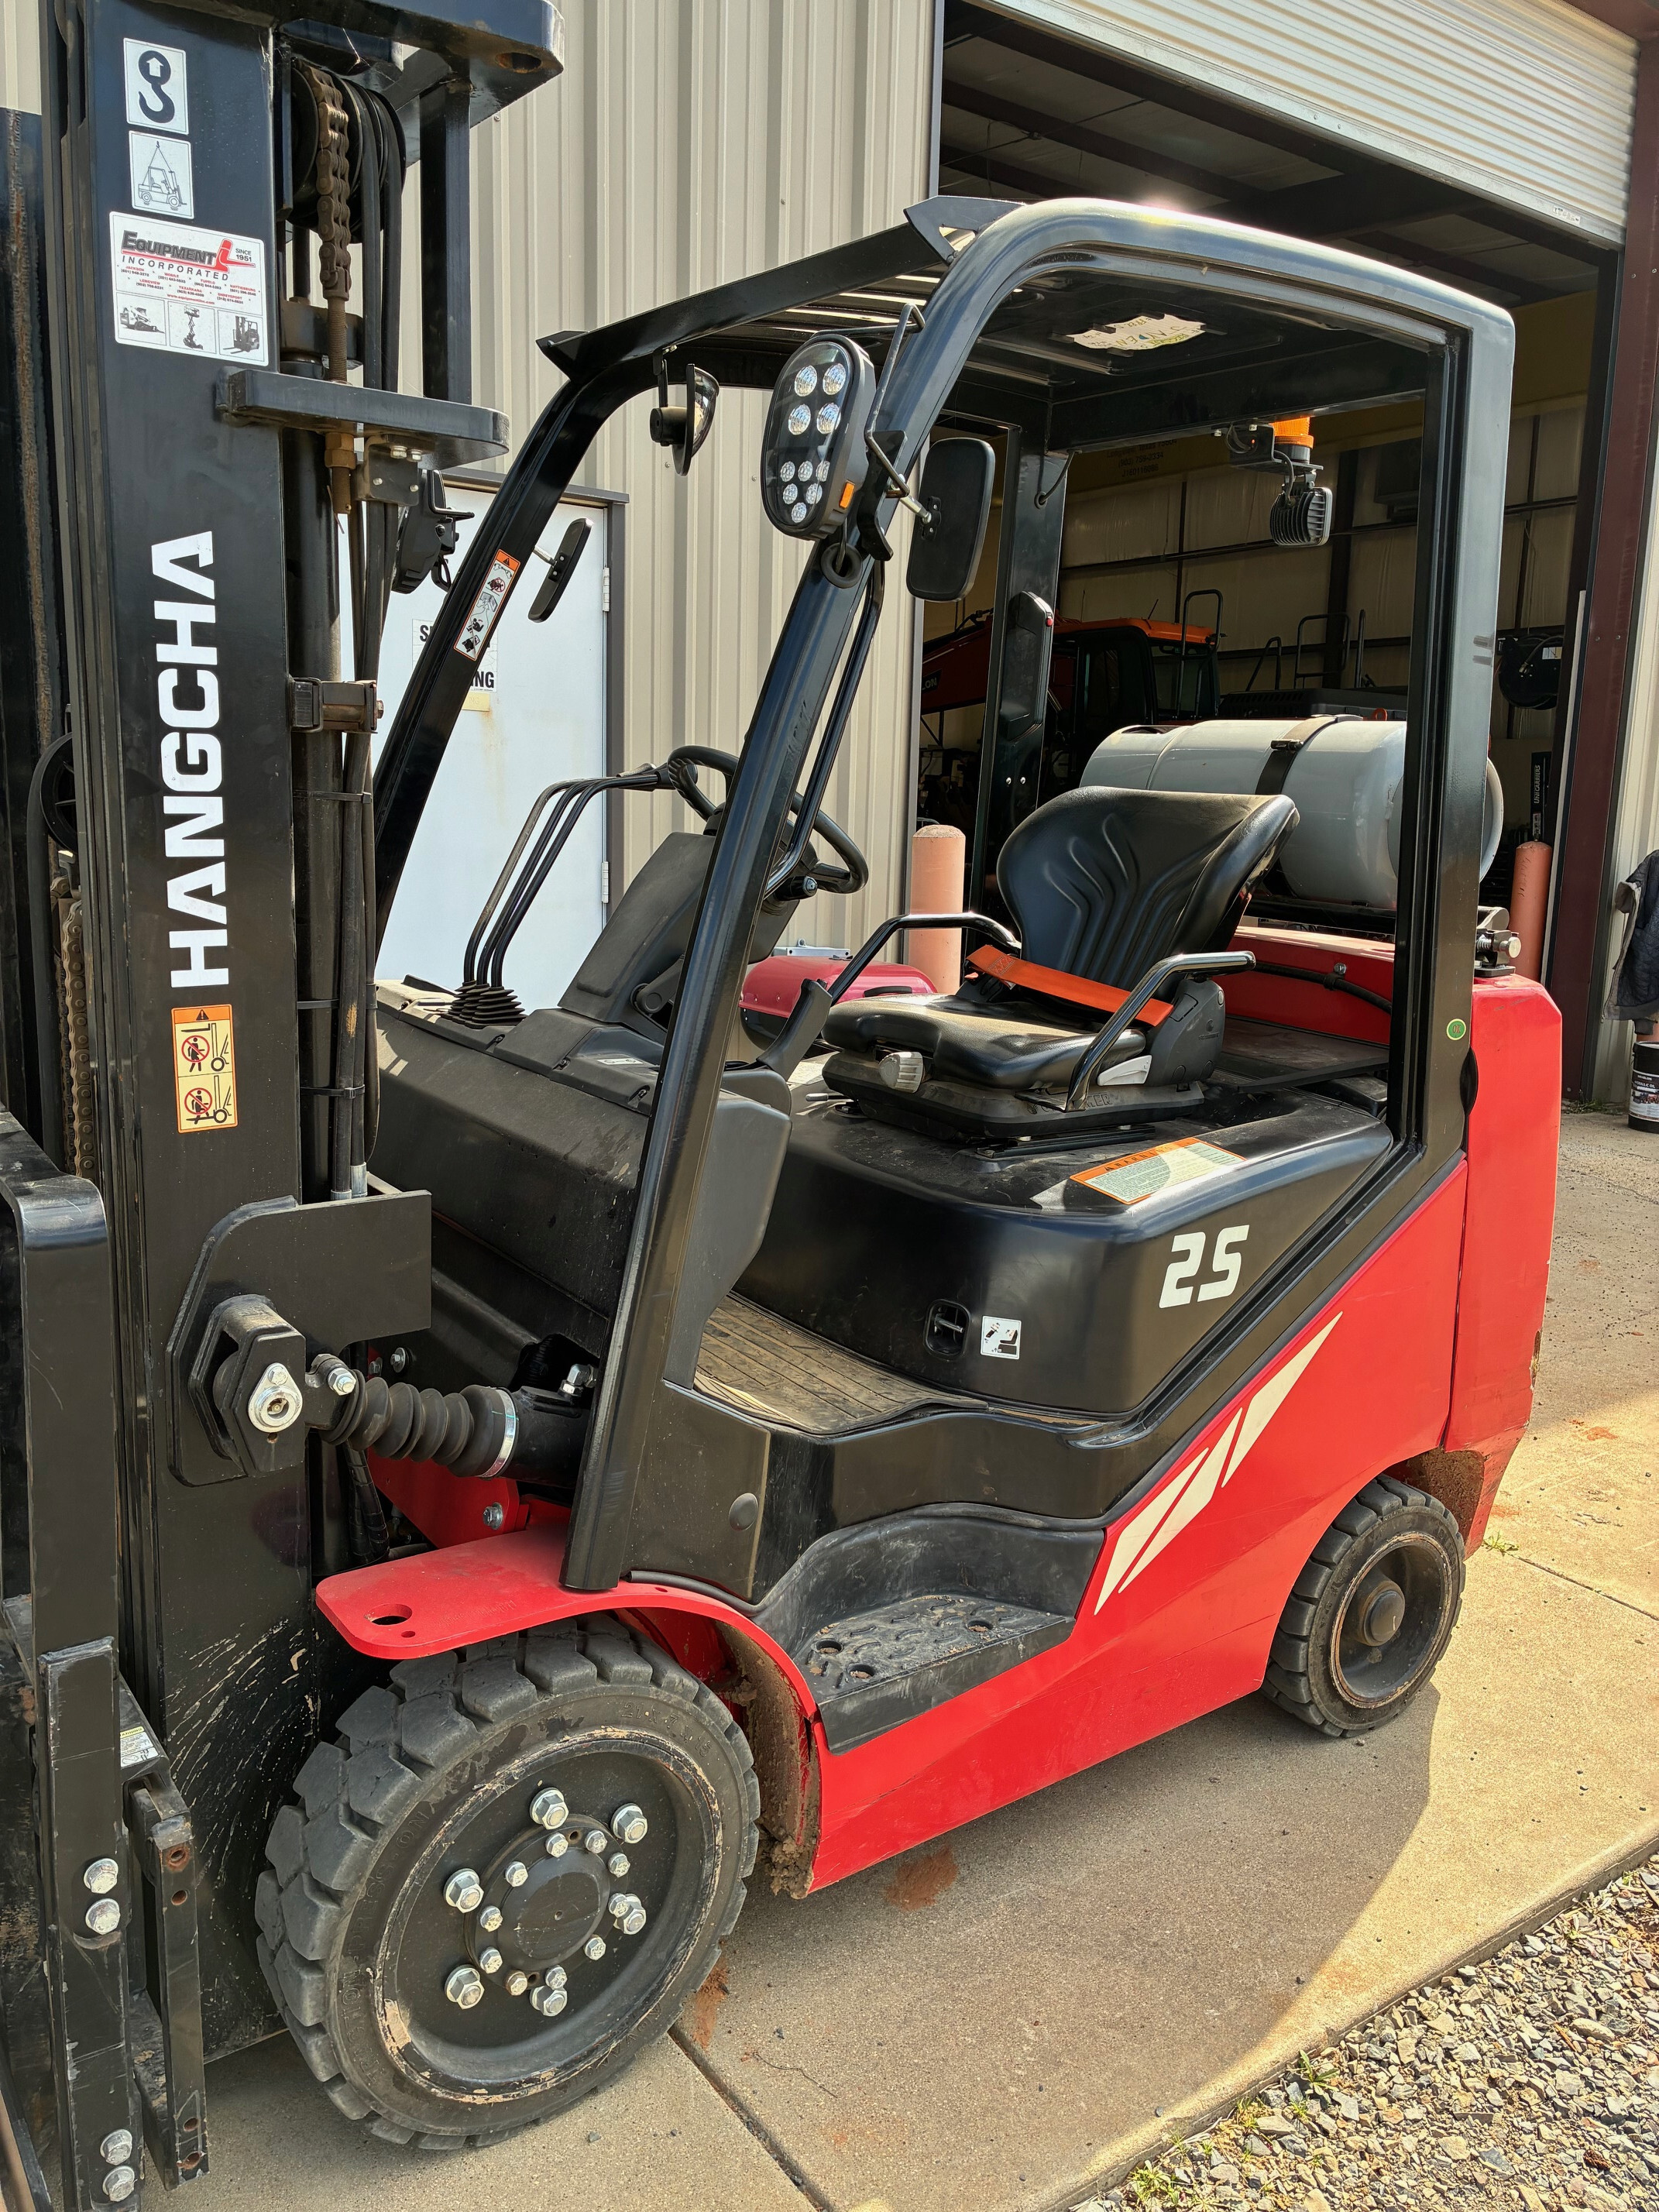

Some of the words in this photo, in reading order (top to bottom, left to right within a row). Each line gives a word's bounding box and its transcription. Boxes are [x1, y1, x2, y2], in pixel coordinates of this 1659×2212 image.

[122, 230, 217, 266] EQUIPMENT
[122, 255, 228, 281] INCORPORATED
[151, 531, 230, 988] HANGCHA
[1452, 1024, 1461, 1033] OK
[1115, 1145, 1173, 1168] WARNING
[1158, 1224, 1249, 1309] 25
